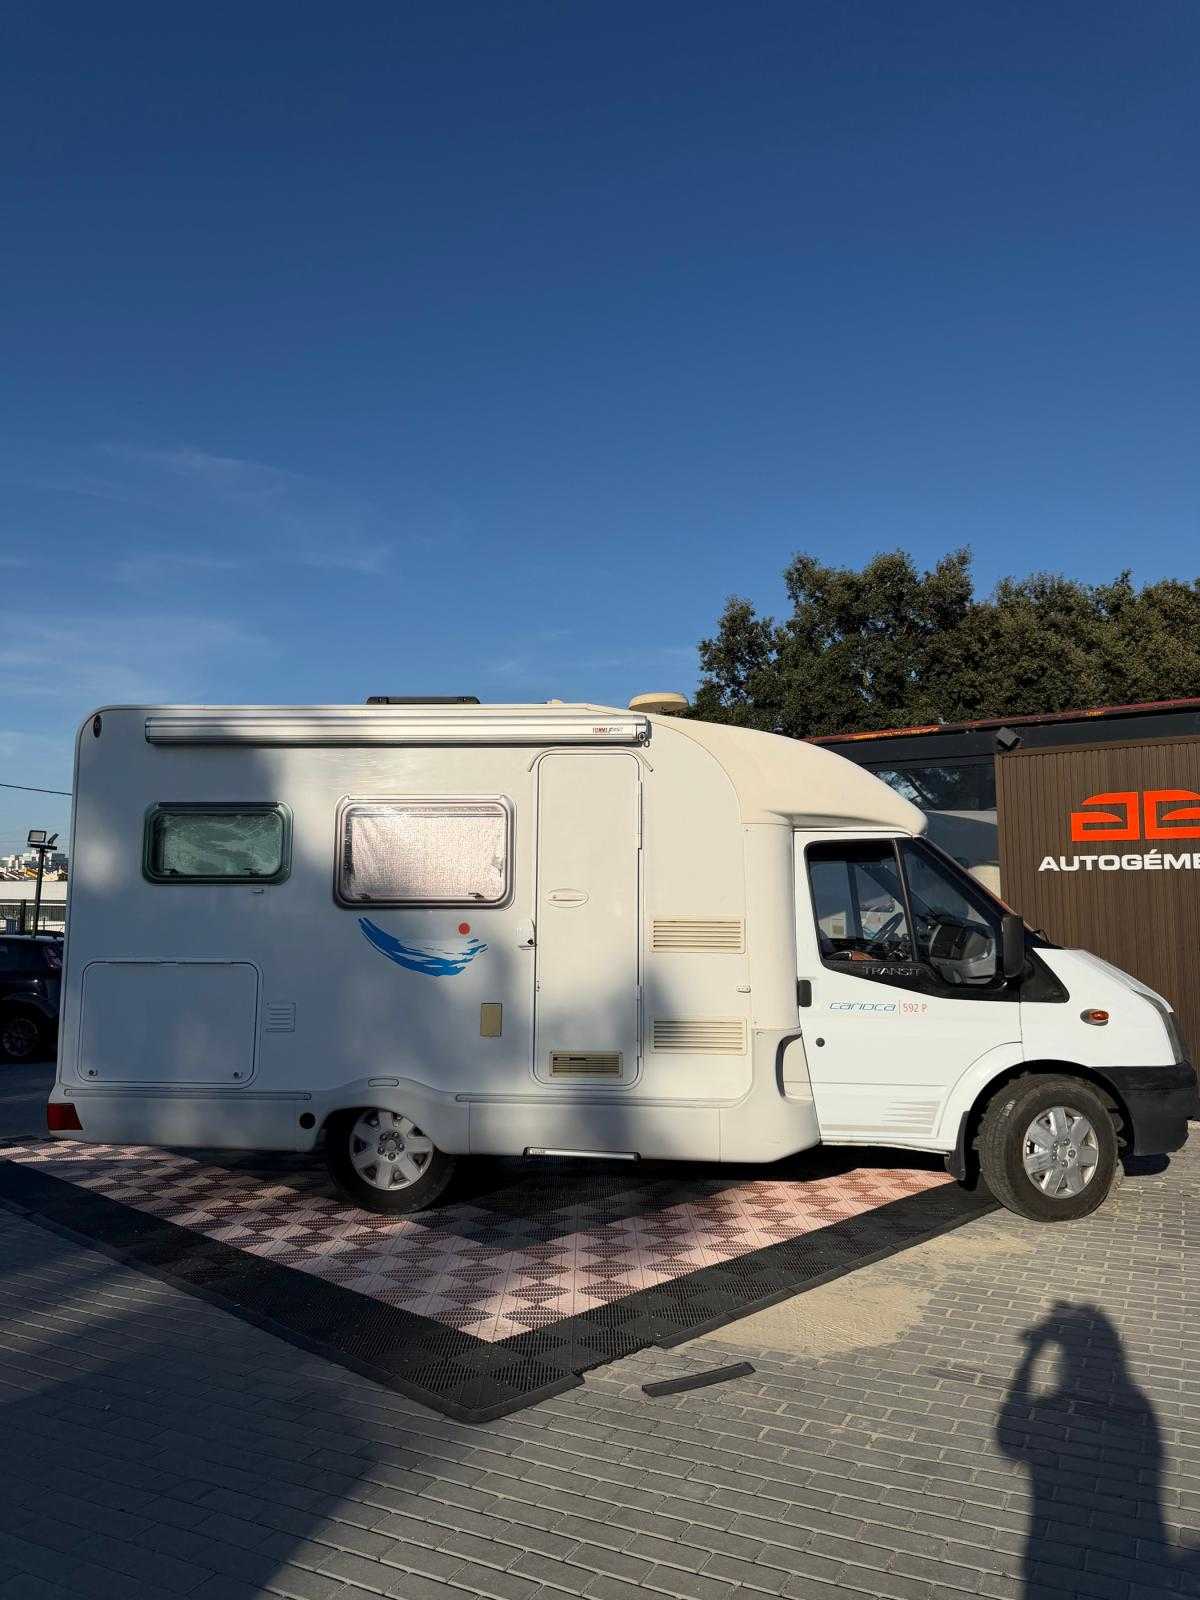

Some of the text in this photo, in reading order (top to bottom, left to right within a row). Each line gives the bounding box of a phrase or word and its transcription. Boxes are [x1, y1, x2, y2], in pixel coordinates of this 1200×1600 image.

[863, 966, 920, 976] TRANSIT
[829, 1002, 897, 1012] carioca
[902, 1003, 919, 1013] 592
